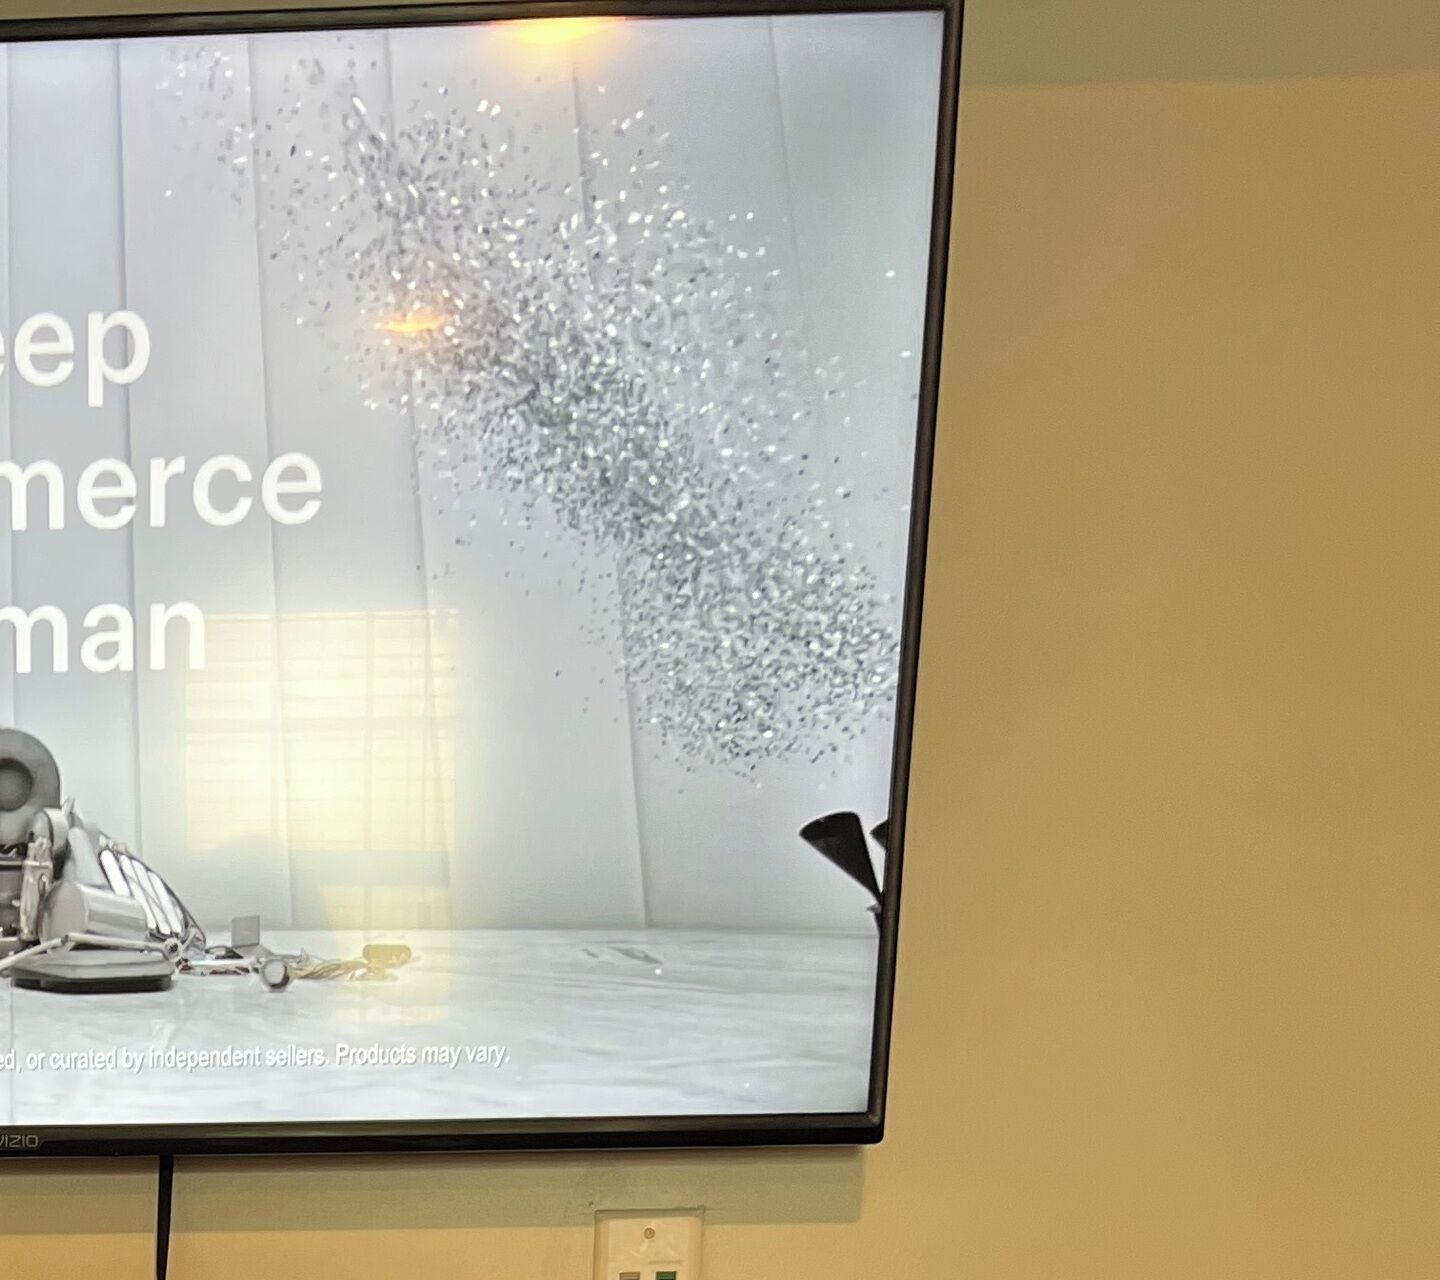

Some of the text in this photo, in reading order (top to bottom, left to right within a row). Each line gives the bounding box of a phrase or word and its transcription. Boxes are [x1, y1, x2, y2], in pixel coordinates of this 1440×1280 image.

[25, 1053, 46, 1070] or
[49, 1048, 118, 1070] curated
[121, 1047, 144, 1074] by
[148, 1046, 261, 1073] independent
[265, 1044, 330, 1067] sellers.
[335, 1043, 417, 1066] Products
[421, 1047, 461, 1071] may
[465, 1045, 511, 1068] vary.
